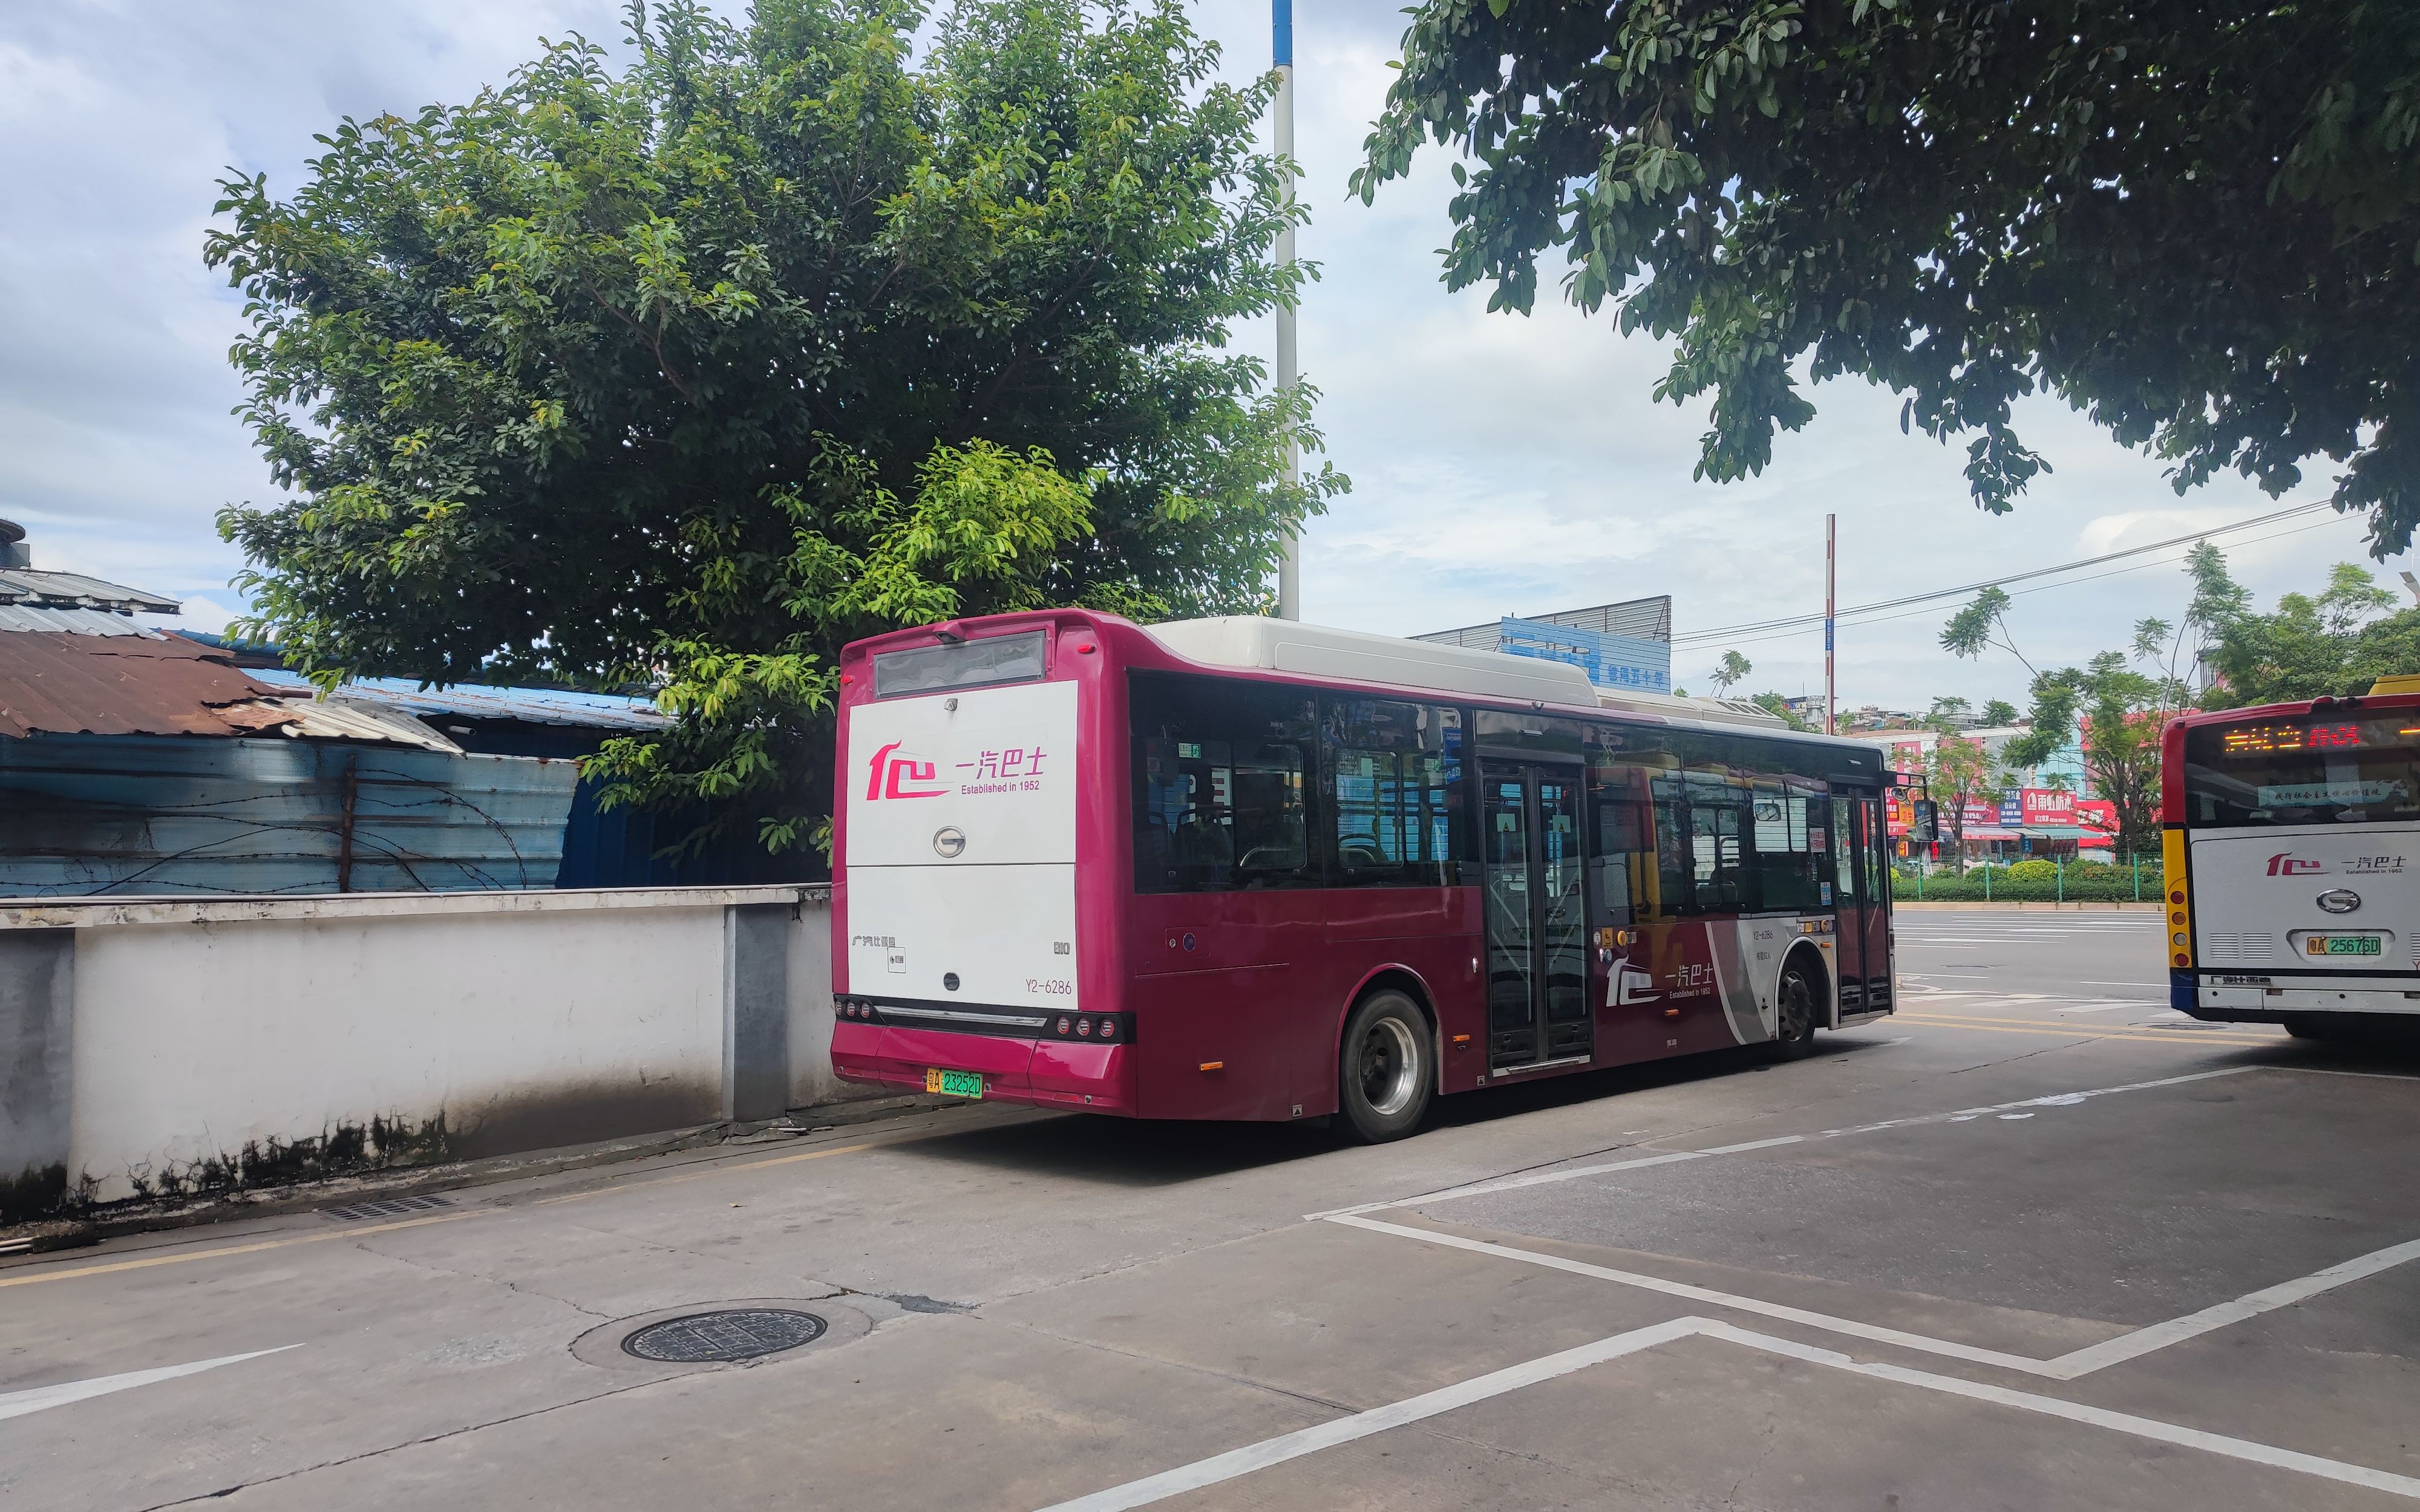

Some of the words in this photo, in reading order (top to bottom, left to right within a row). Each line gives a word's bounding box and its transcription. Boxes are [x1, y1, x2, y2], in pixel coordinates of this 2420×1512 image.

[955, 746, 1047, 779] 一汽巴士
[961, 782, 1007, 795] Established
[1009, 782, 1016, 792] in
[1019, 780, 1040, 791] 1952
[2038, 794, 2072, 811] 雨虹防水
[2340, 856, 2407, 868] 一汽巴士
[1753, 930, 1773, 940] Y2-6286
[1664, 962, 1713, 987] 一汽巴士
[1025, 979, 1071, 994] Y2-6286
[1670, 989, 1695, 999] Established
[1701, 986, 1711, 996] 1952
